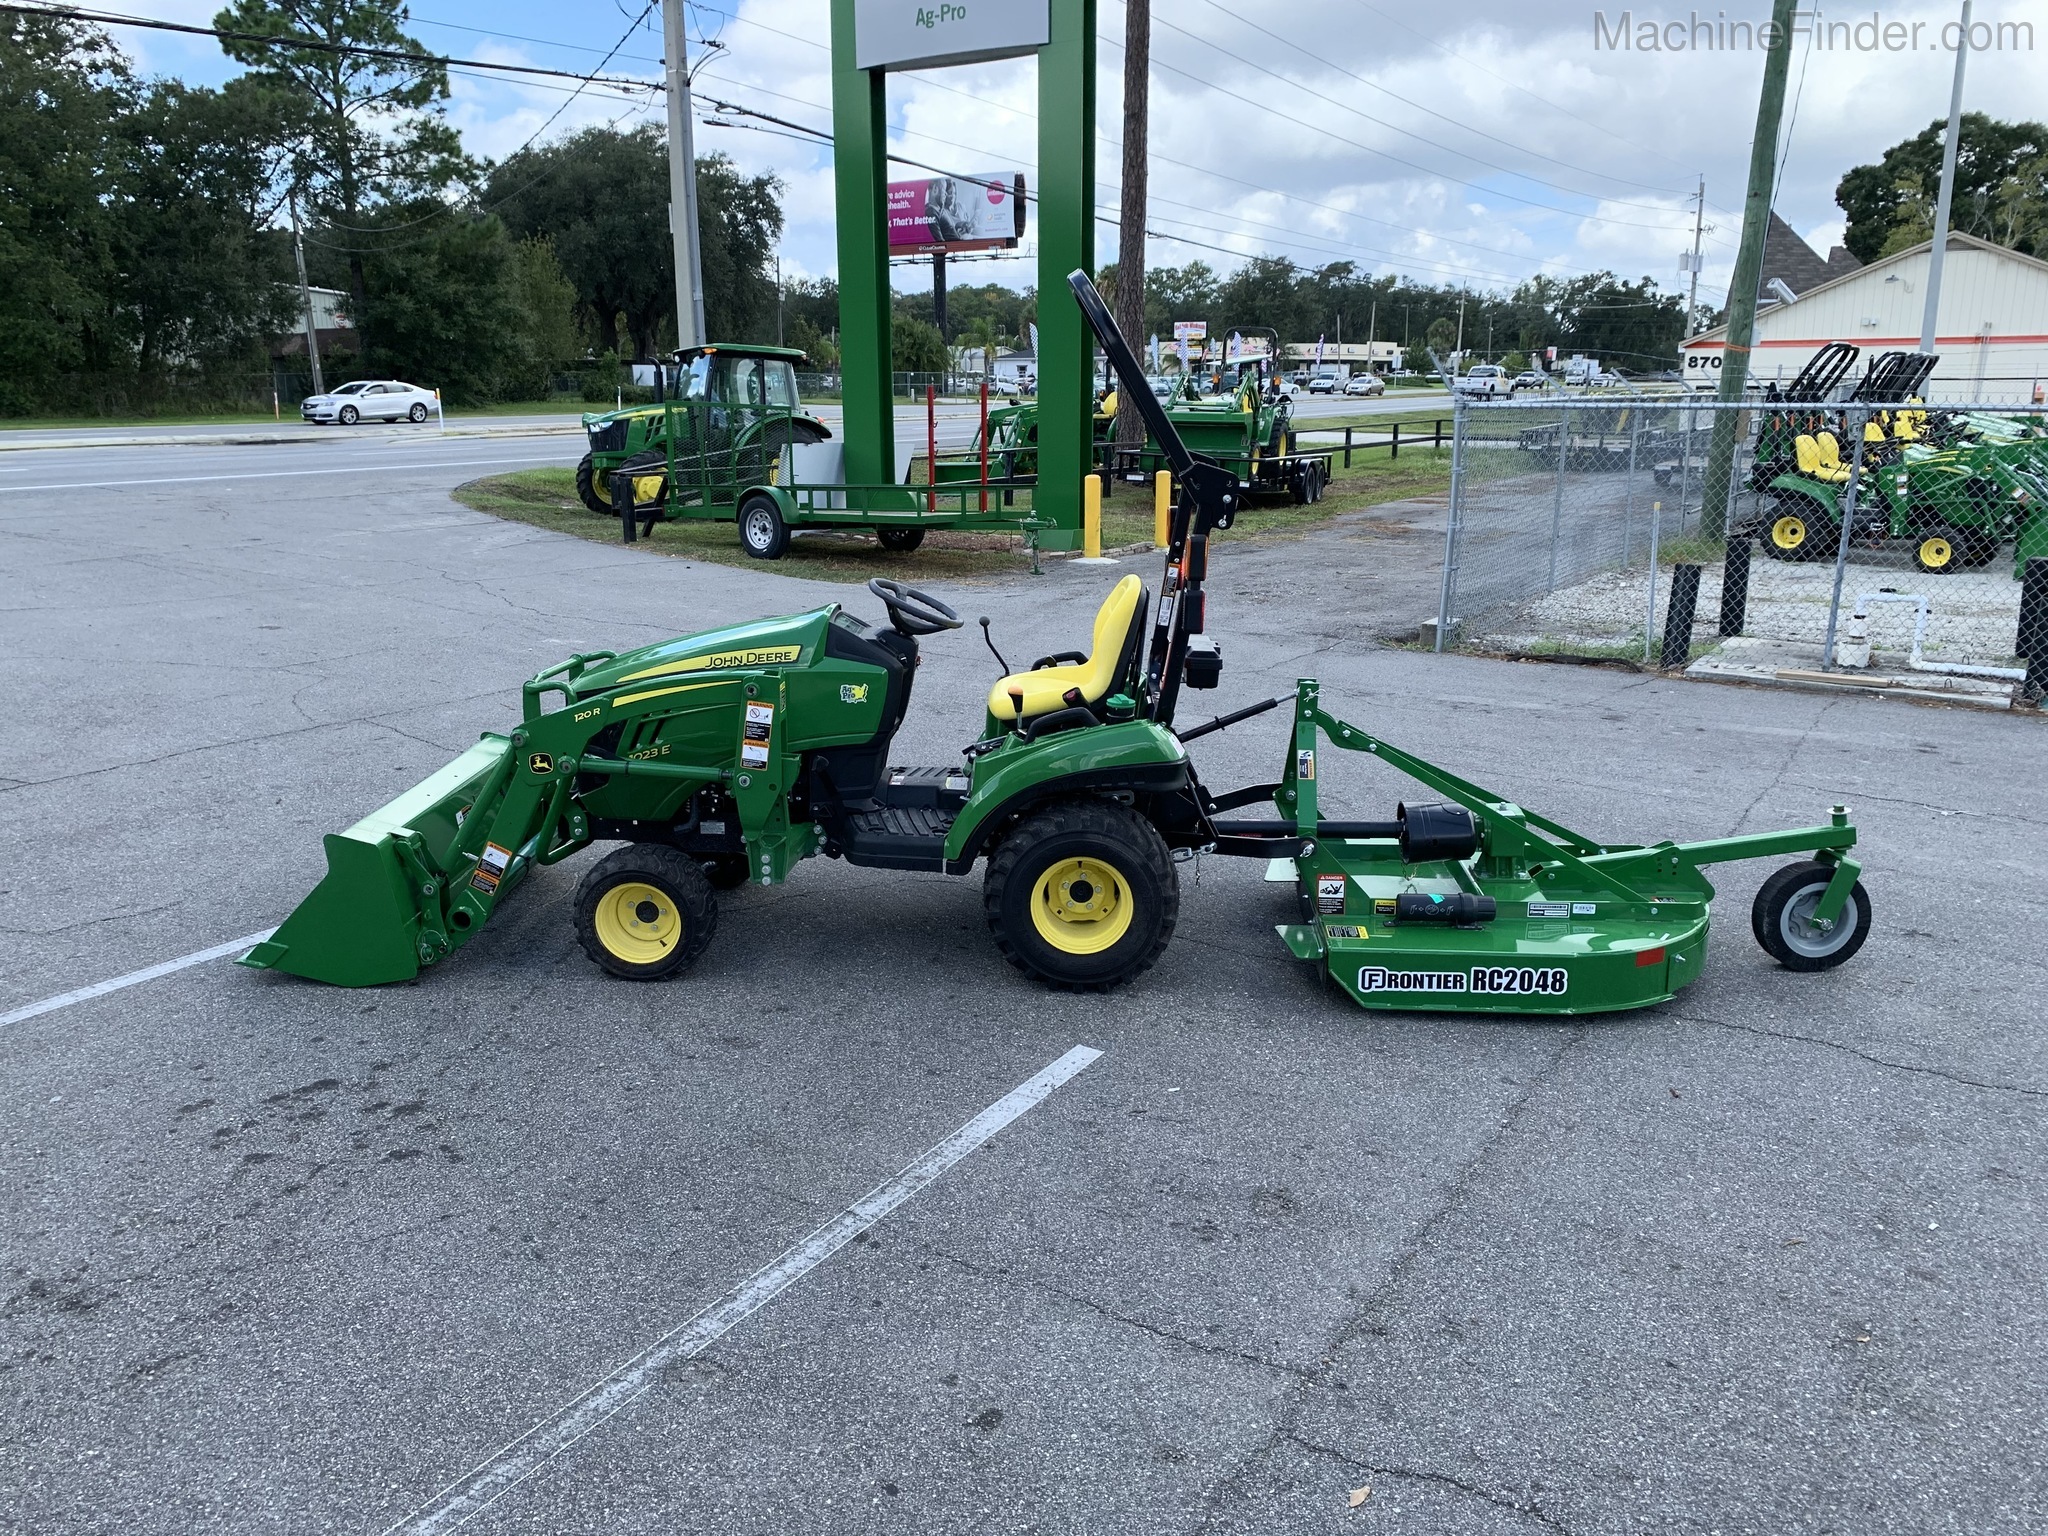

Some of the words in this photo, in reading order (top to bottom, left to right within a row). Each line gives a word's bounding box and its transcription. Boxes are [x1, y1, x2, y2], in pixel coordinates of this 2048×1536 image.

[916, 4, 966, 29] Ag-Pro
[894, 189, 915, 199] advice
[888, 200, 911, 210] health.
[893, 217, 913, 227] That's
[914, 216, 936, 225] Better.
[1688, 356, 1722, 369] 870
[705, 656, 743, 668] JOHN
[747, 652, 792, 664] DEERE
[1361, 968, 1465, 991] FRONTIER
[1472, 969, 1566, 993] RC2048
